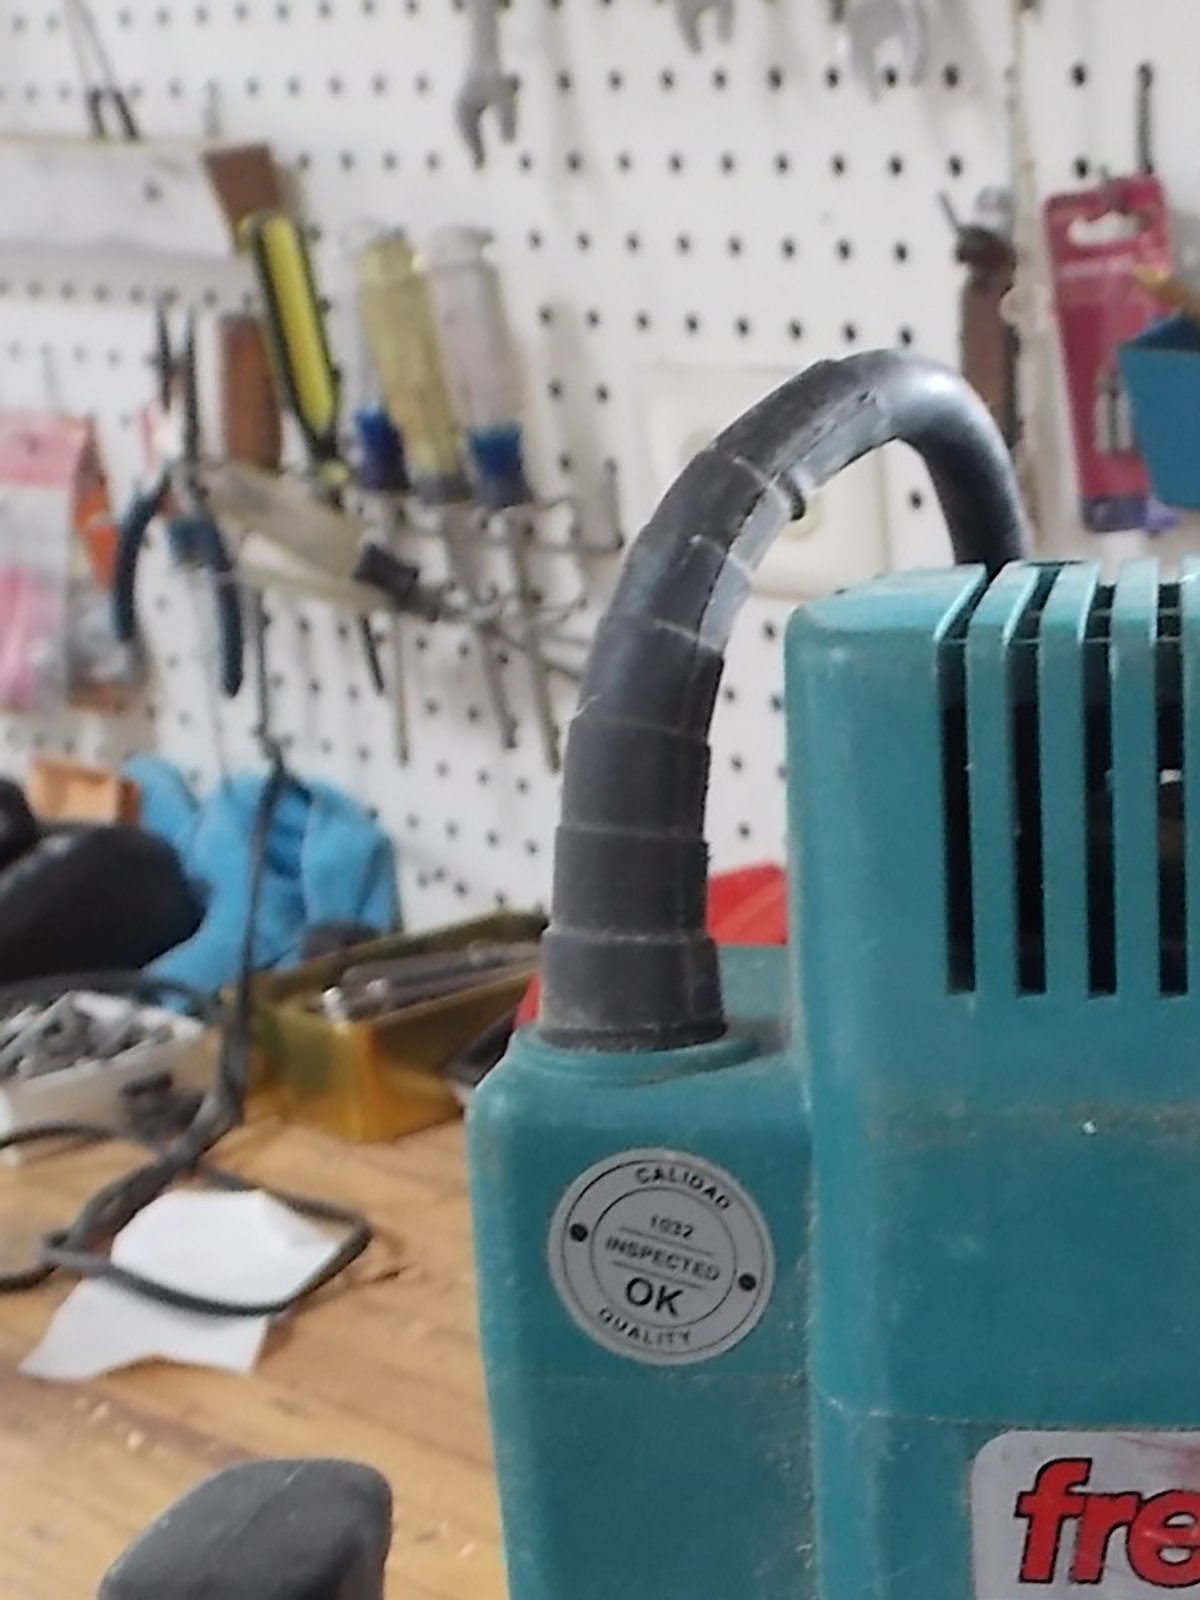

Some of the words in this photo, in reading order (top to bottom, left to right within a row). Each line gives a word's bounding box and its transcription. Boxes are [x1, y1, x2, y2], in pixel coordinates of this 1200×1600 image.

[635, 1167, 731, 1210] CALIDAD
[605, 1236, 721, 1281] INSPECTED
[626, 1277, 683, 1317] OK
[599, 1308, 691, 1345] QUALITY
